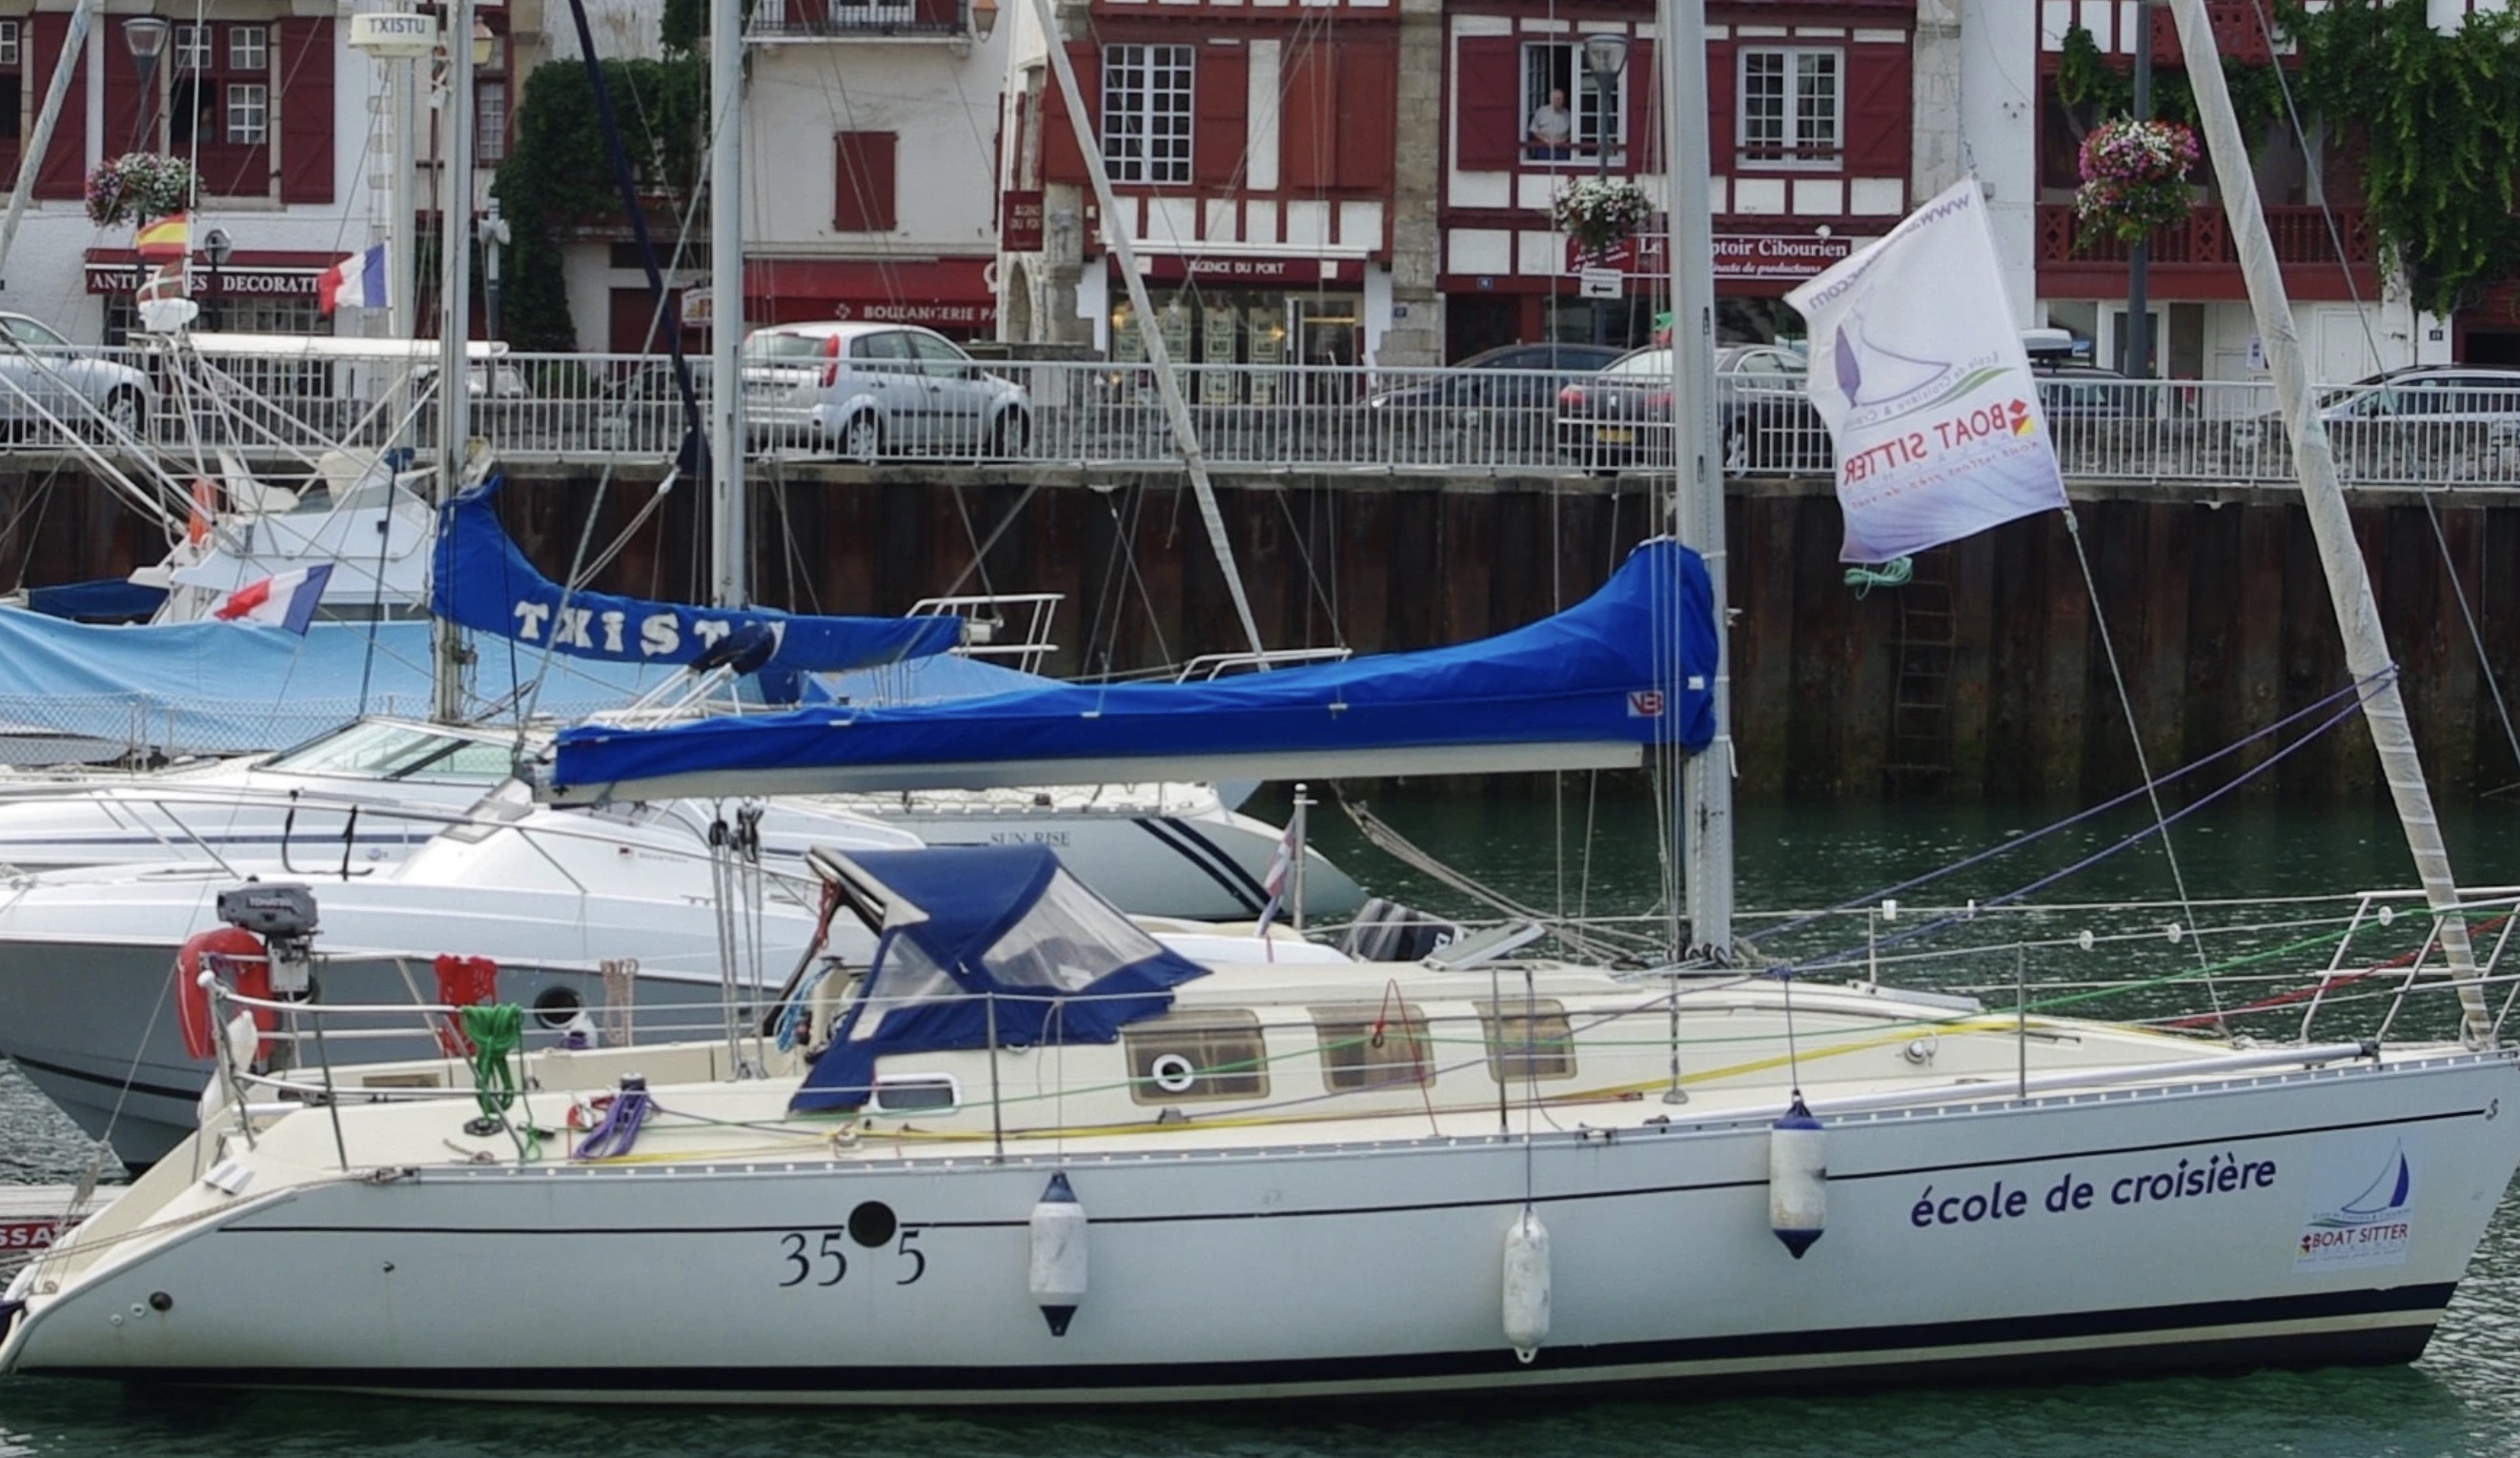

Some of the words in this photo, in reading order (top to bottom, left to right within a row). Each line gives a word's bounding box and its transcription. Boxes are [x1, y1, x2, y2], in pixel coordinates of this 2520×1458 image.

[369, 17, 425, 33] TXISTU
[1758, 238, 1847, 256] Cibourien
[1190, 260, 1230, 273] AGENCE
[1235, 261, 1251, 273] DU
[1255, 262, 1285, 273] PORT
[223, 275, 317, 293] DECORATI
[864, 306, 974, 320] BOULANGERIE
[1033, 831, 1071, 847] RISE
[1910, 1185, 2028, 1227] école
[2044, 1173, 2094, 1213] de
[2110, 1151, 2277, 1205] croisière
[2312, 1229, 2356, 1248] BOAT
[2358, 1224, 2408, 1243] SITTER
[779, 1232, 847, 1286] 35
[896, 1229, 925, 1286] 5
